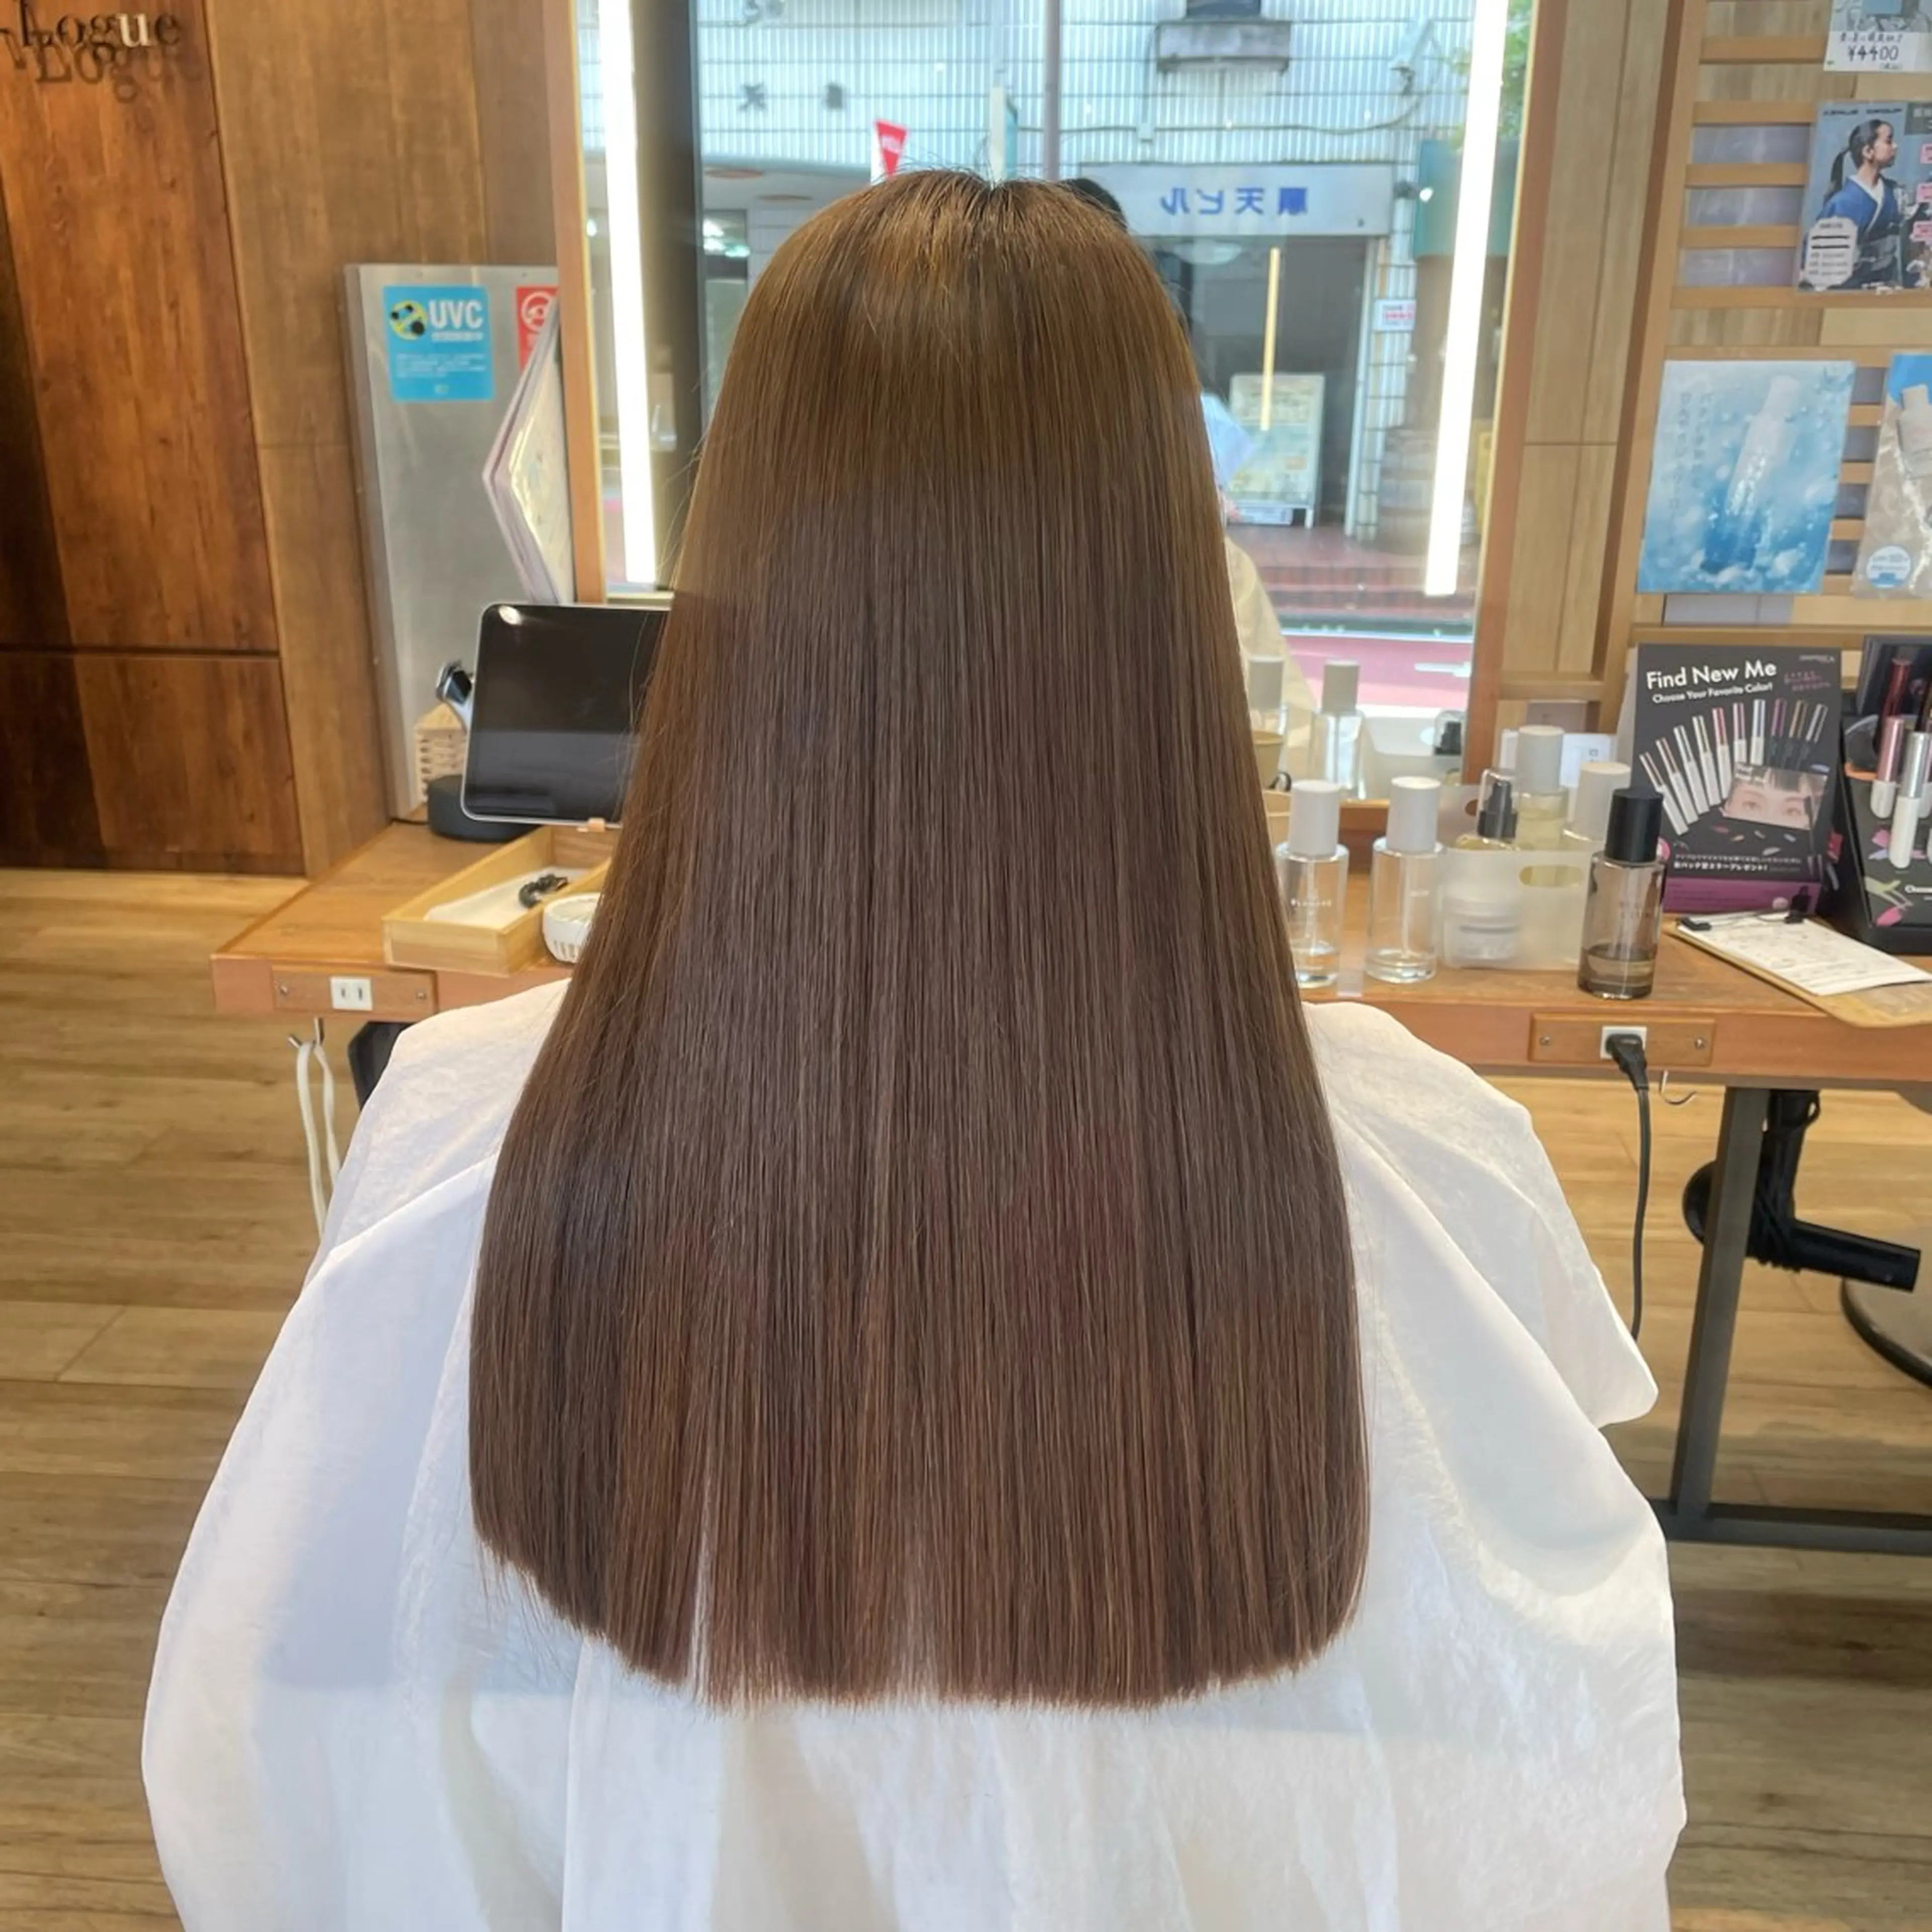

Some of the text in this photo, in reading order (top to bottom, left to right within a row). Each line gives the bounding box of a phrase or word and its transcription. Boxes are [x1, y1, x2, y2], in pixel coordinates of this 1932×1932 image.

[429, 299, 485, 330] UVC
[1646, 666, 1687, 690] Find
[1692, 664, 1739, 685] New
[1744, 659, 1777, 679] Me
